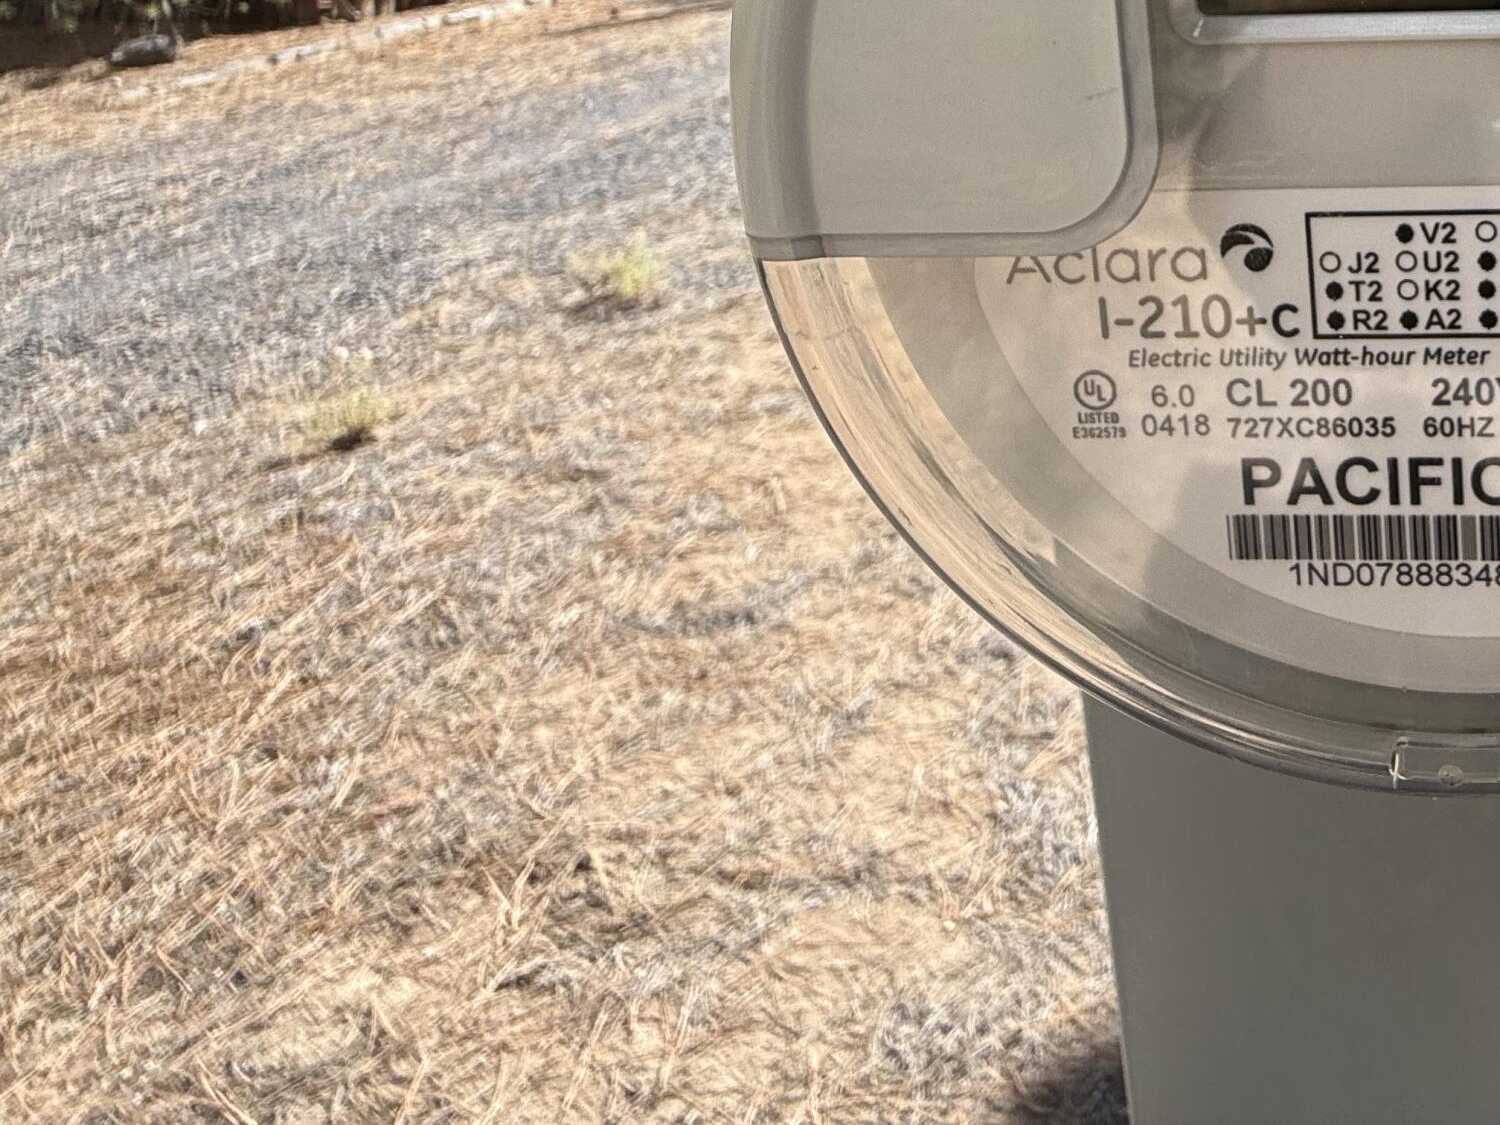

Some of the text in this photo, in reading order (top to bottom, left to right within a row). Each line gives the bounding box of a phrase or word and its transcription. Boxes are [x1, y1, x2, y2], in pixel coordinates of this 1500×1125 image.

[1419, 221, 1457, 244] V2
[1005, 245, 1209, 285] Aclara
[1347, 251, 1380, 274] J2
[1423, 250, 1460, 273] U2
[1348, 280, 1383, 302] T2
[1424, 279, 1461, 302] K2
[1352, 308, 1389, 331] R2
[1424, 308, 1463, 331] A2
[1128, 346, 1491, 371] Electric Utility Watt-hour Meter
[1151, 384, 1196, 408] 6.0
[1226, 377, 1278, 407] CL
[1289, 377, 1353, 407] 200
[1077, 411, 1120, 424] LISTED
[1141, 413, 1211, 437] 0418
[1226, 416, 1396, 439] 727XC86035
[1422, 416, 1495, 438] 60HZ
